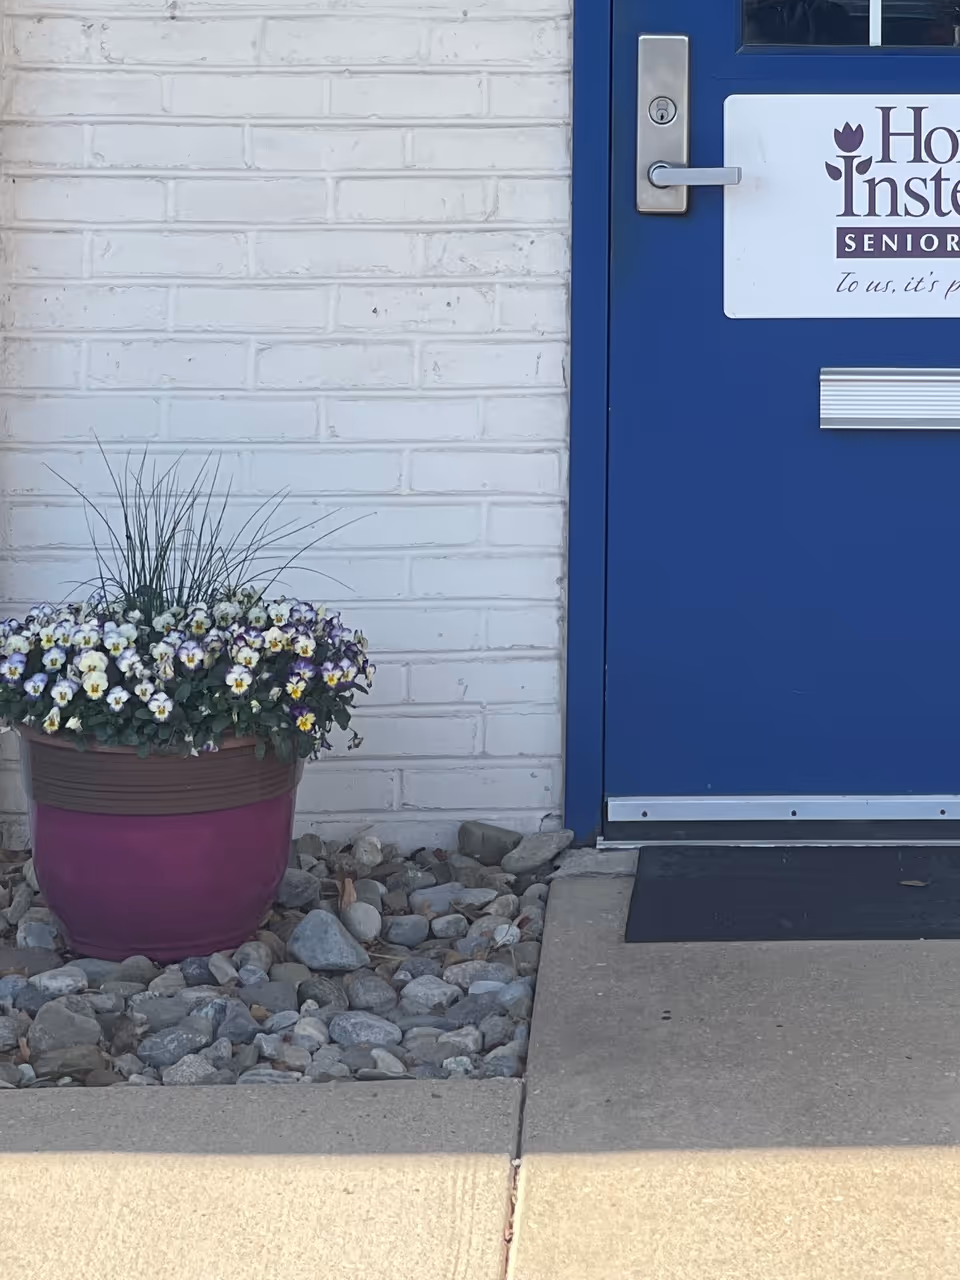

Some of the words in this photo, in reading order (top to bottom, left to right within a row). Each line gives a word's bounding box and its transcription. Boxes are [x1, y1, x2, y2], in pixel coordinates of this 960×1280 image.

[844, 233, 960, 252] SENIOR
[836, 271, 859, 293] To
[865, 279, 896, 294] us,
[903, 271, 940, 293] it's
